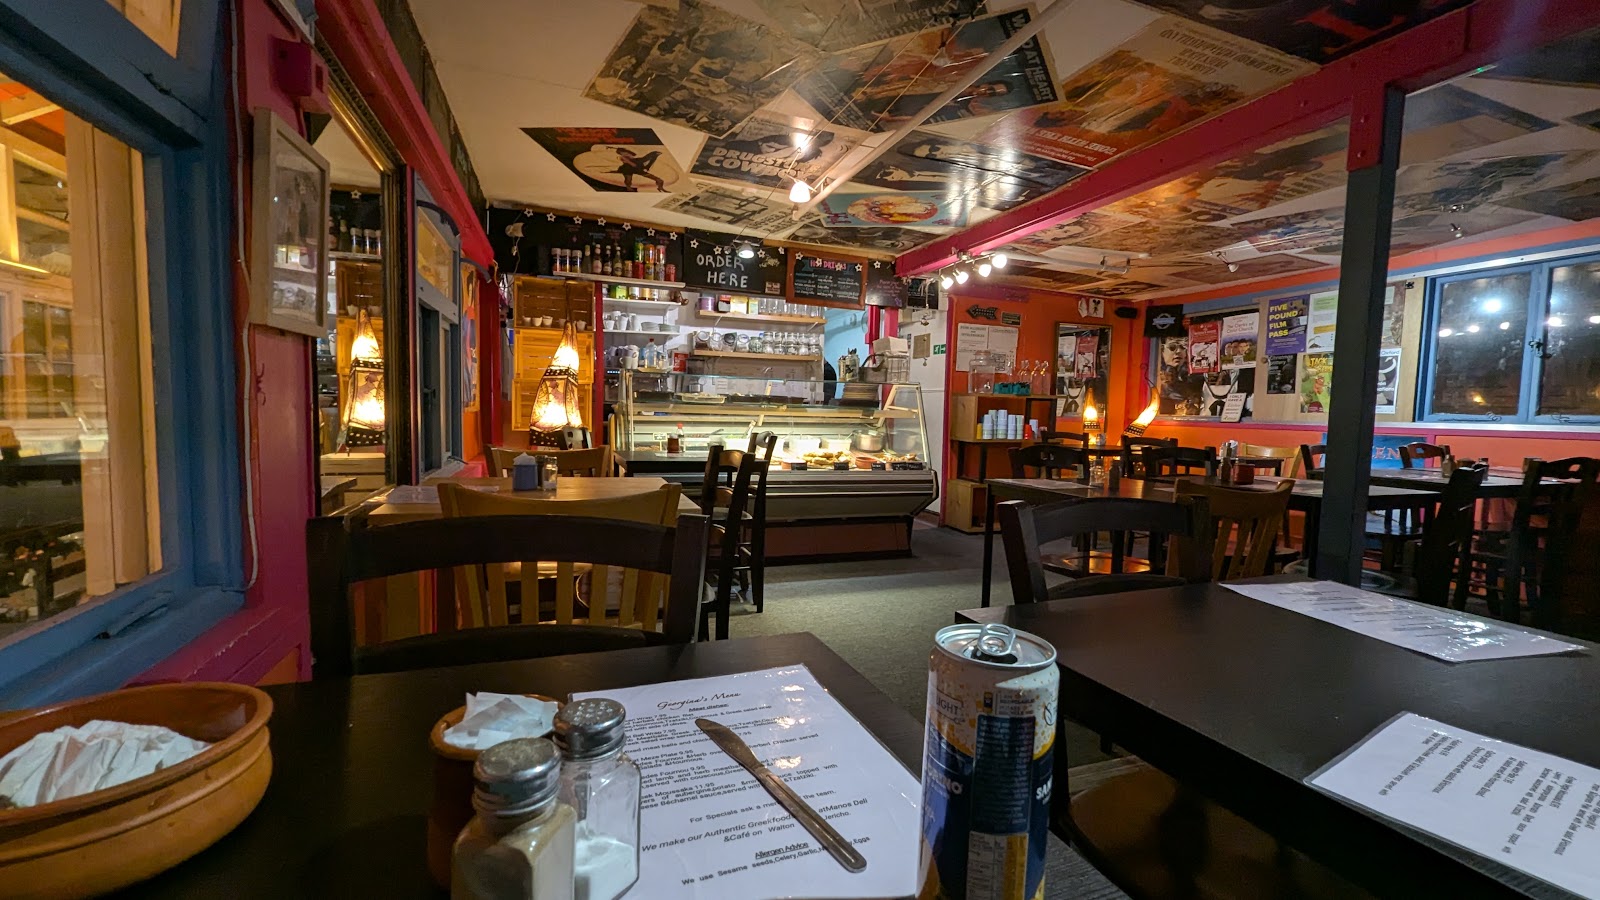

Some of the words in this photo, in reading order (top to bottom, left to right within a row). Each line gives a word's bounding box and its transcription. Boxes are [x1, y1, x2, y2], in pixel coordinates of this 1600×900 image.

[1024, 50, 1040, 66] AT
[1033, 66, 1054, 100] HEART
[696, 254, 744, 271] ORDER
[707, 271, 748, 288] HERE
[1268, 310, 1298, 321] POUND
[1269, 303, 1288, 313] FIVE
[1269, 320, 1287, 330] FILM
[1268, 329, 1289, 338] PASS
[657, 696, 708, 711] Georgina's
[710, 692, 742, 701] Menu
[772, 737, 797, 745] Chicken
[796, 766, 820, 775] topped
[655, 786, 693, 797] Moussaka
[694, 782, 715, 790] 11.95
[815, 789, 837, 797] team.
[690, 816, 703, 824] For
[705, 808, 739, 821] Specials
[740, 805, 754, 813] ask
[642, 843, 658, 853] We
[659, 837, 686, 849] make
[687, 833, 704, 842] our
[704, 823, 746, 840] Authentic
[852, 797, 869, 806] Deli
[723, 830, 751, 843] &Café
[752, 829, 763, 837] on
[768, 822, 795, 833] Walton
[681, 877, 696, 886] We
[698, 873, 714, 882] use
[717, 864, 748, 878] Sesame
